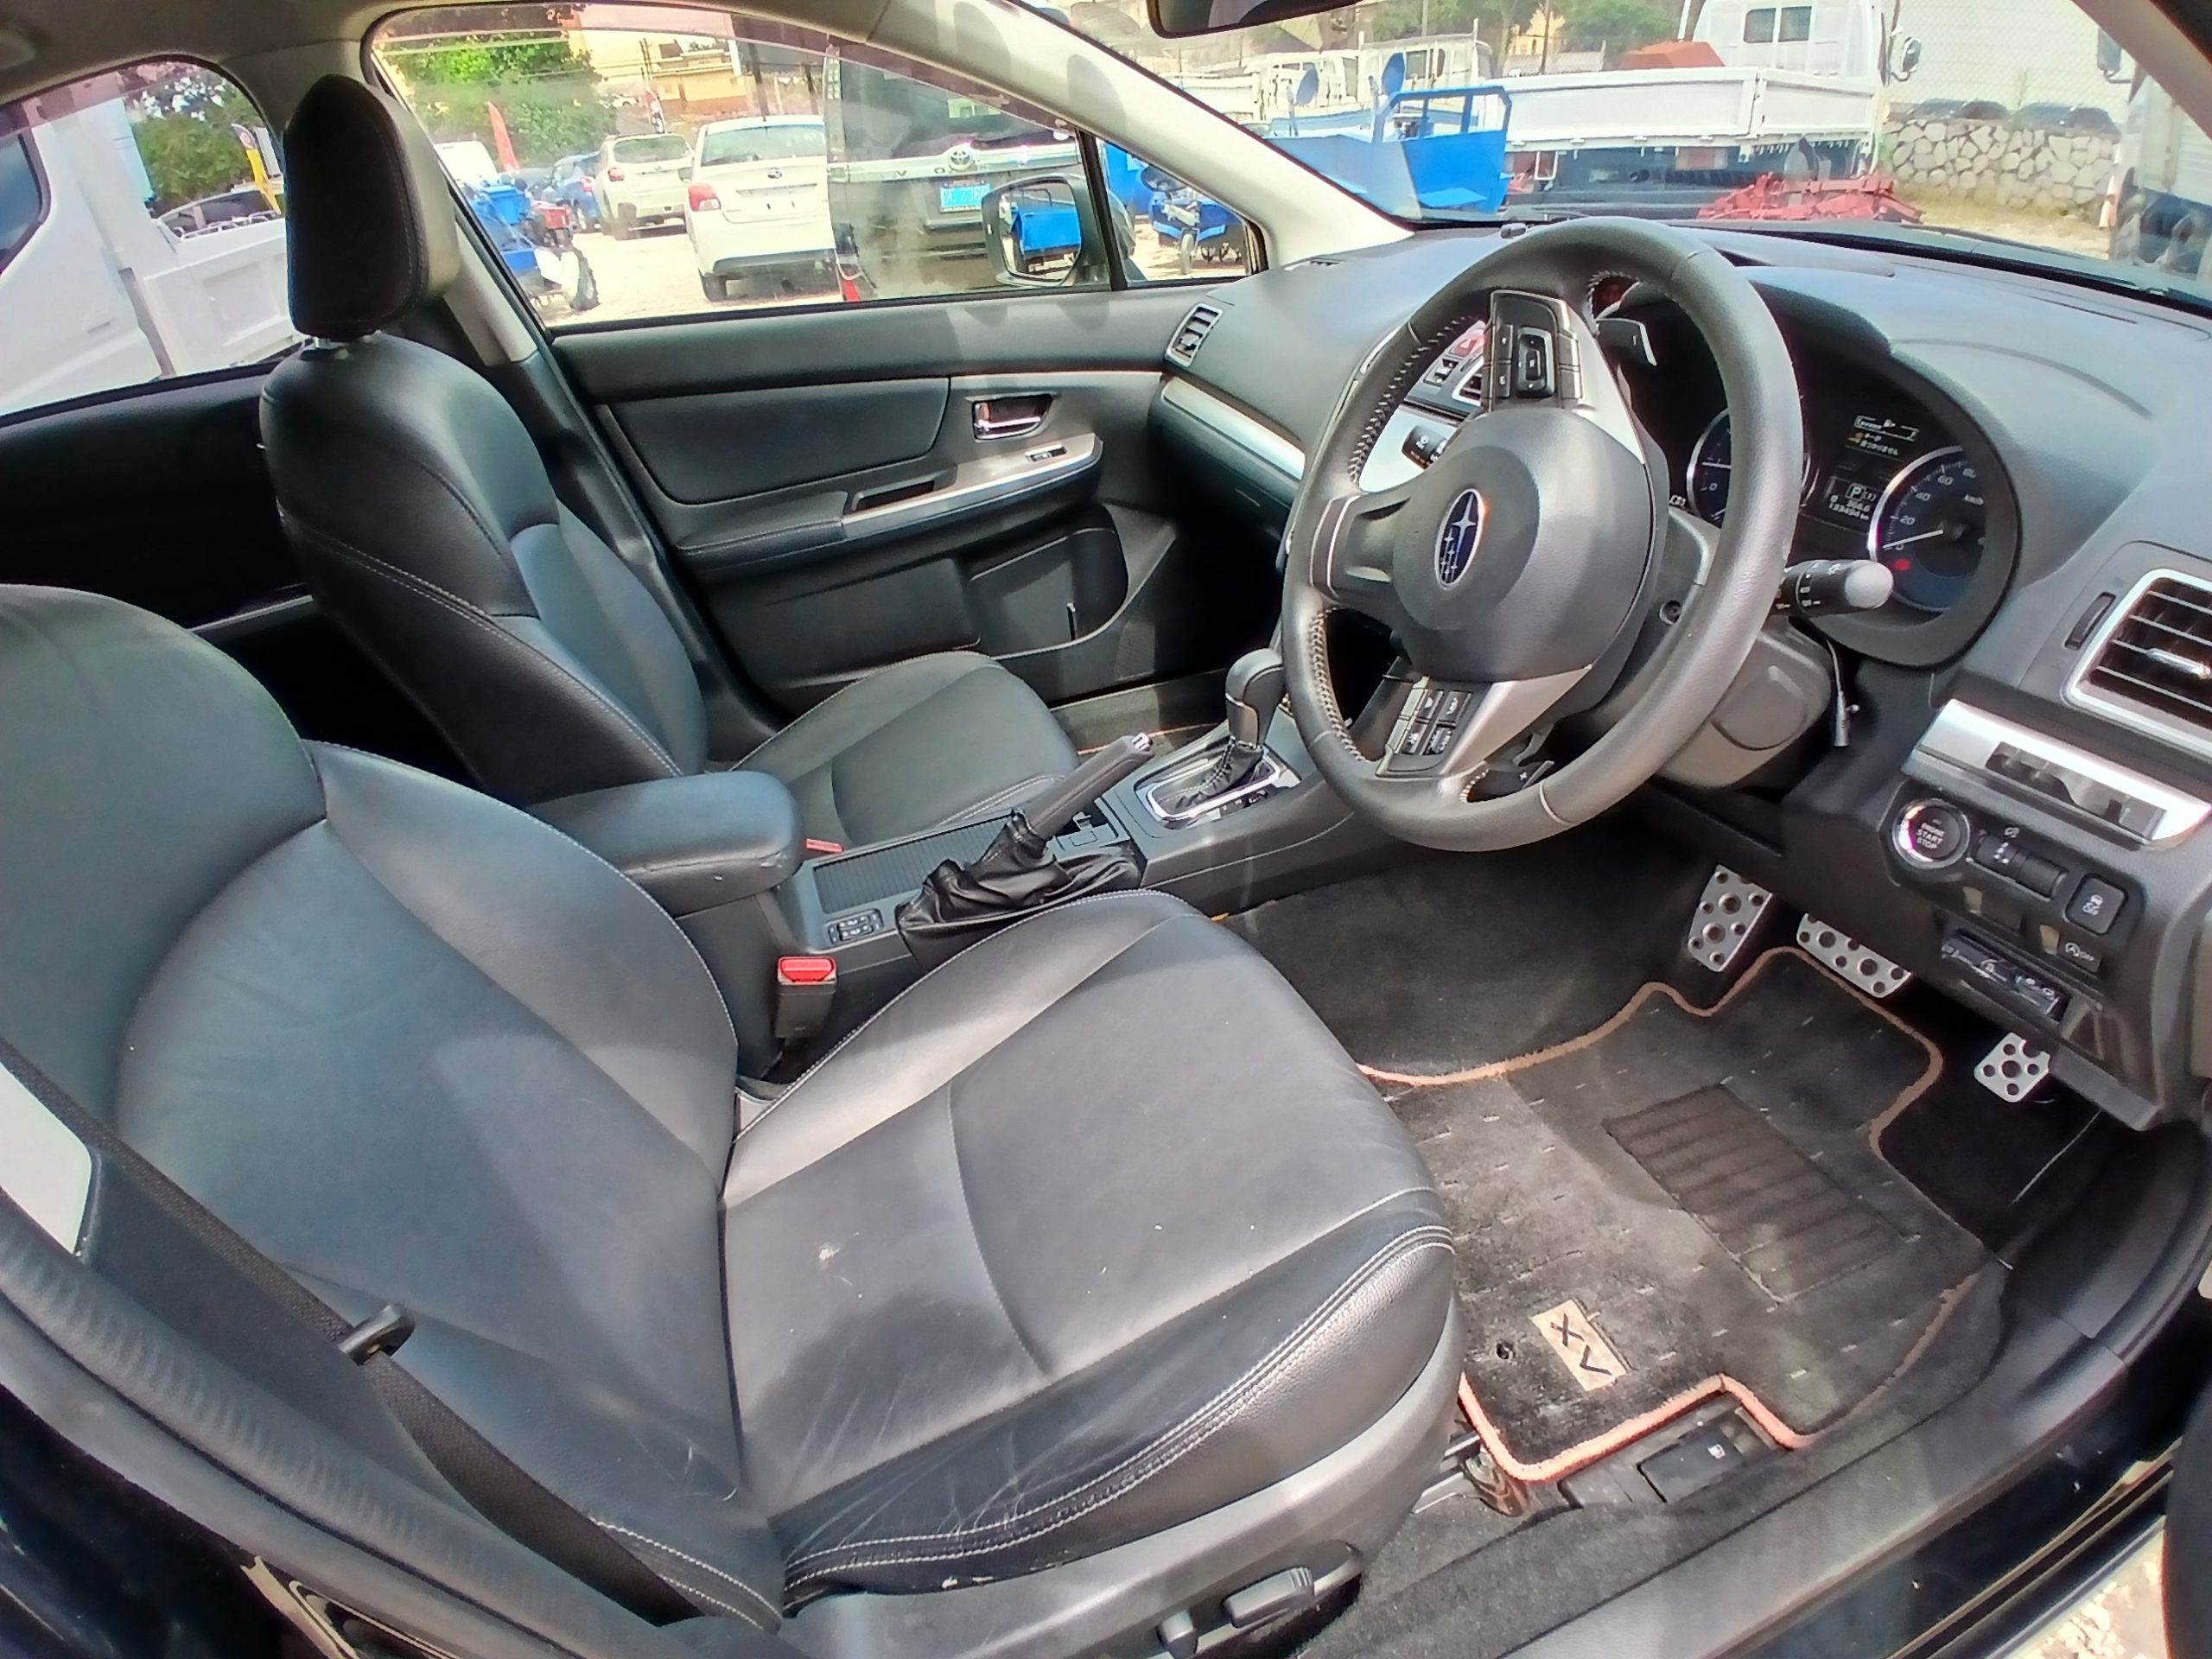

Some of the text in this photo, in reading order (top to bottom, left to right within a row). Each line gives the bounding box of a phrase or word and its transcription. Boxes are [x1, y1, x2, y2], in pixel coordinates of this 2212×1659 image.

[1937, 474, 1954, 486] 60
[1849, 486, 1862, 499] P
[1915, 492, 1931, 501] 40
[1899, 515, 1916, 525] 20
[1916, 829, 1943, 844] START
[1916, 836, 1937, 849] STOP
[1550, 1313, 1612, 1376] XV
